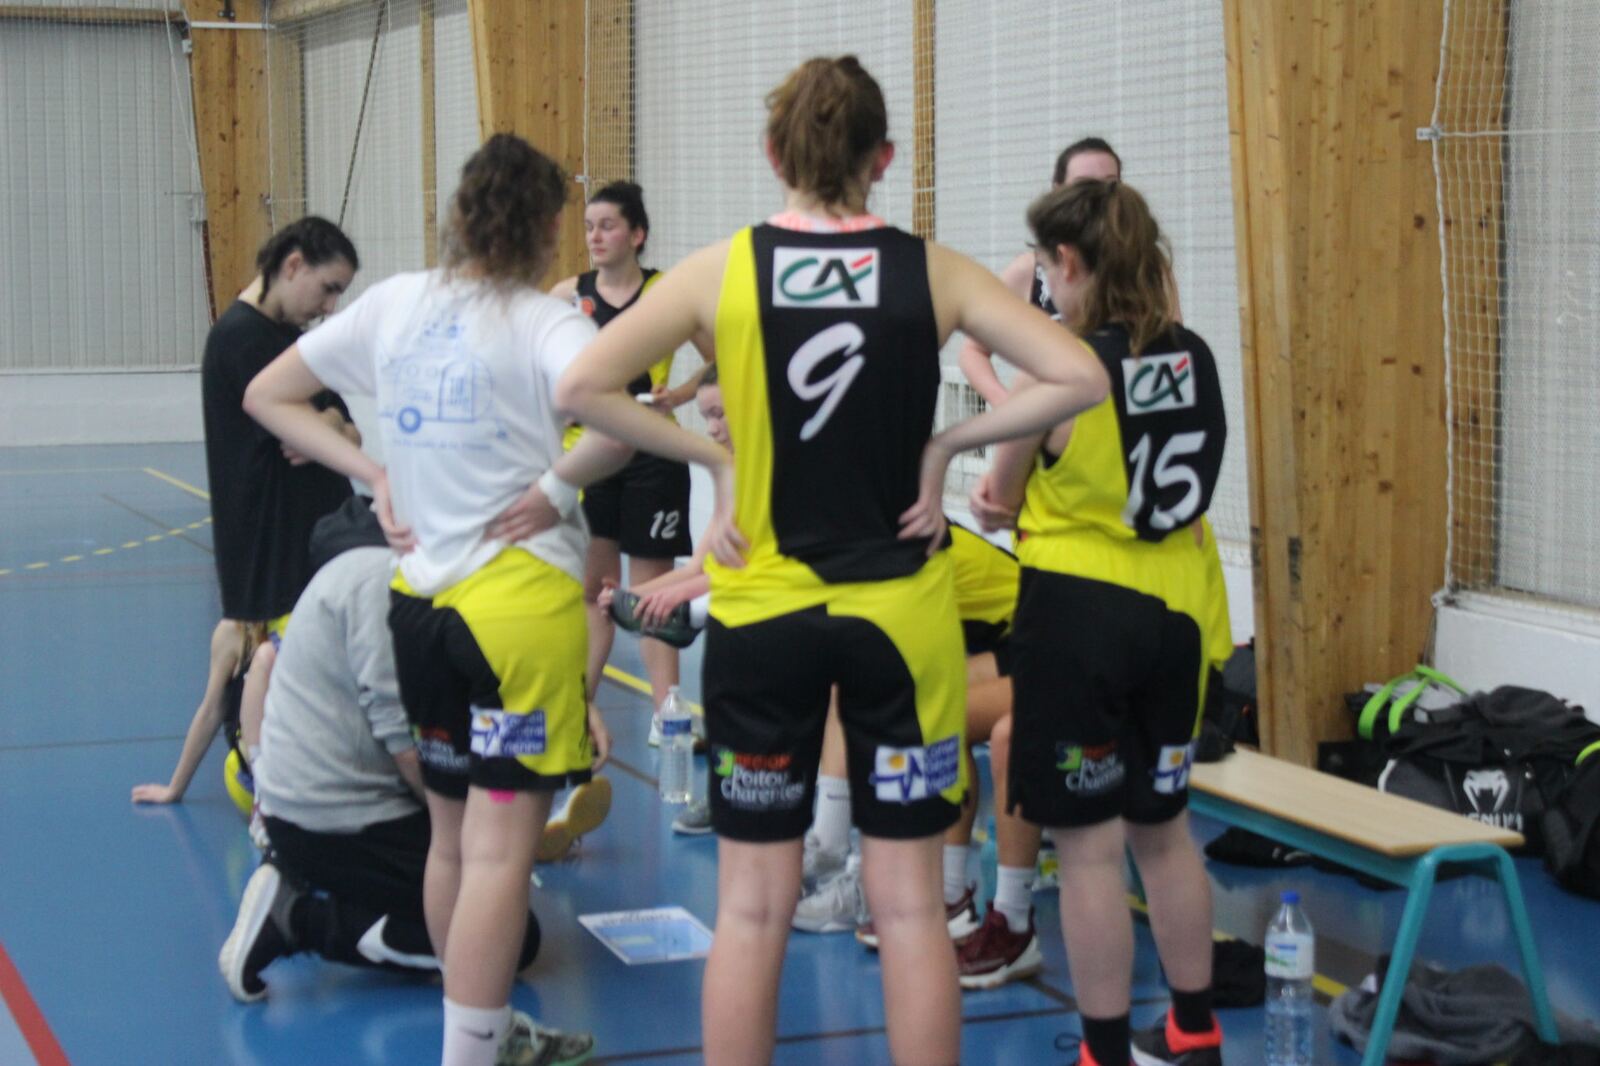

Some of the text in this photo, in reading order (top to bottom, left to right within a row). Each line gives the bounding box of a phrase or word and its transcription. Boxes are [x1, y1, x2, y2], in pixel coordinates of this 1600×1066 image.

[779, 254, 873, 302] CA
[787, 321, 865, 441] 9
[1129, 357, 1190, 409] CA
[1121, 430, 1207, 530] 15
[649, 510, 680, 539] 12
